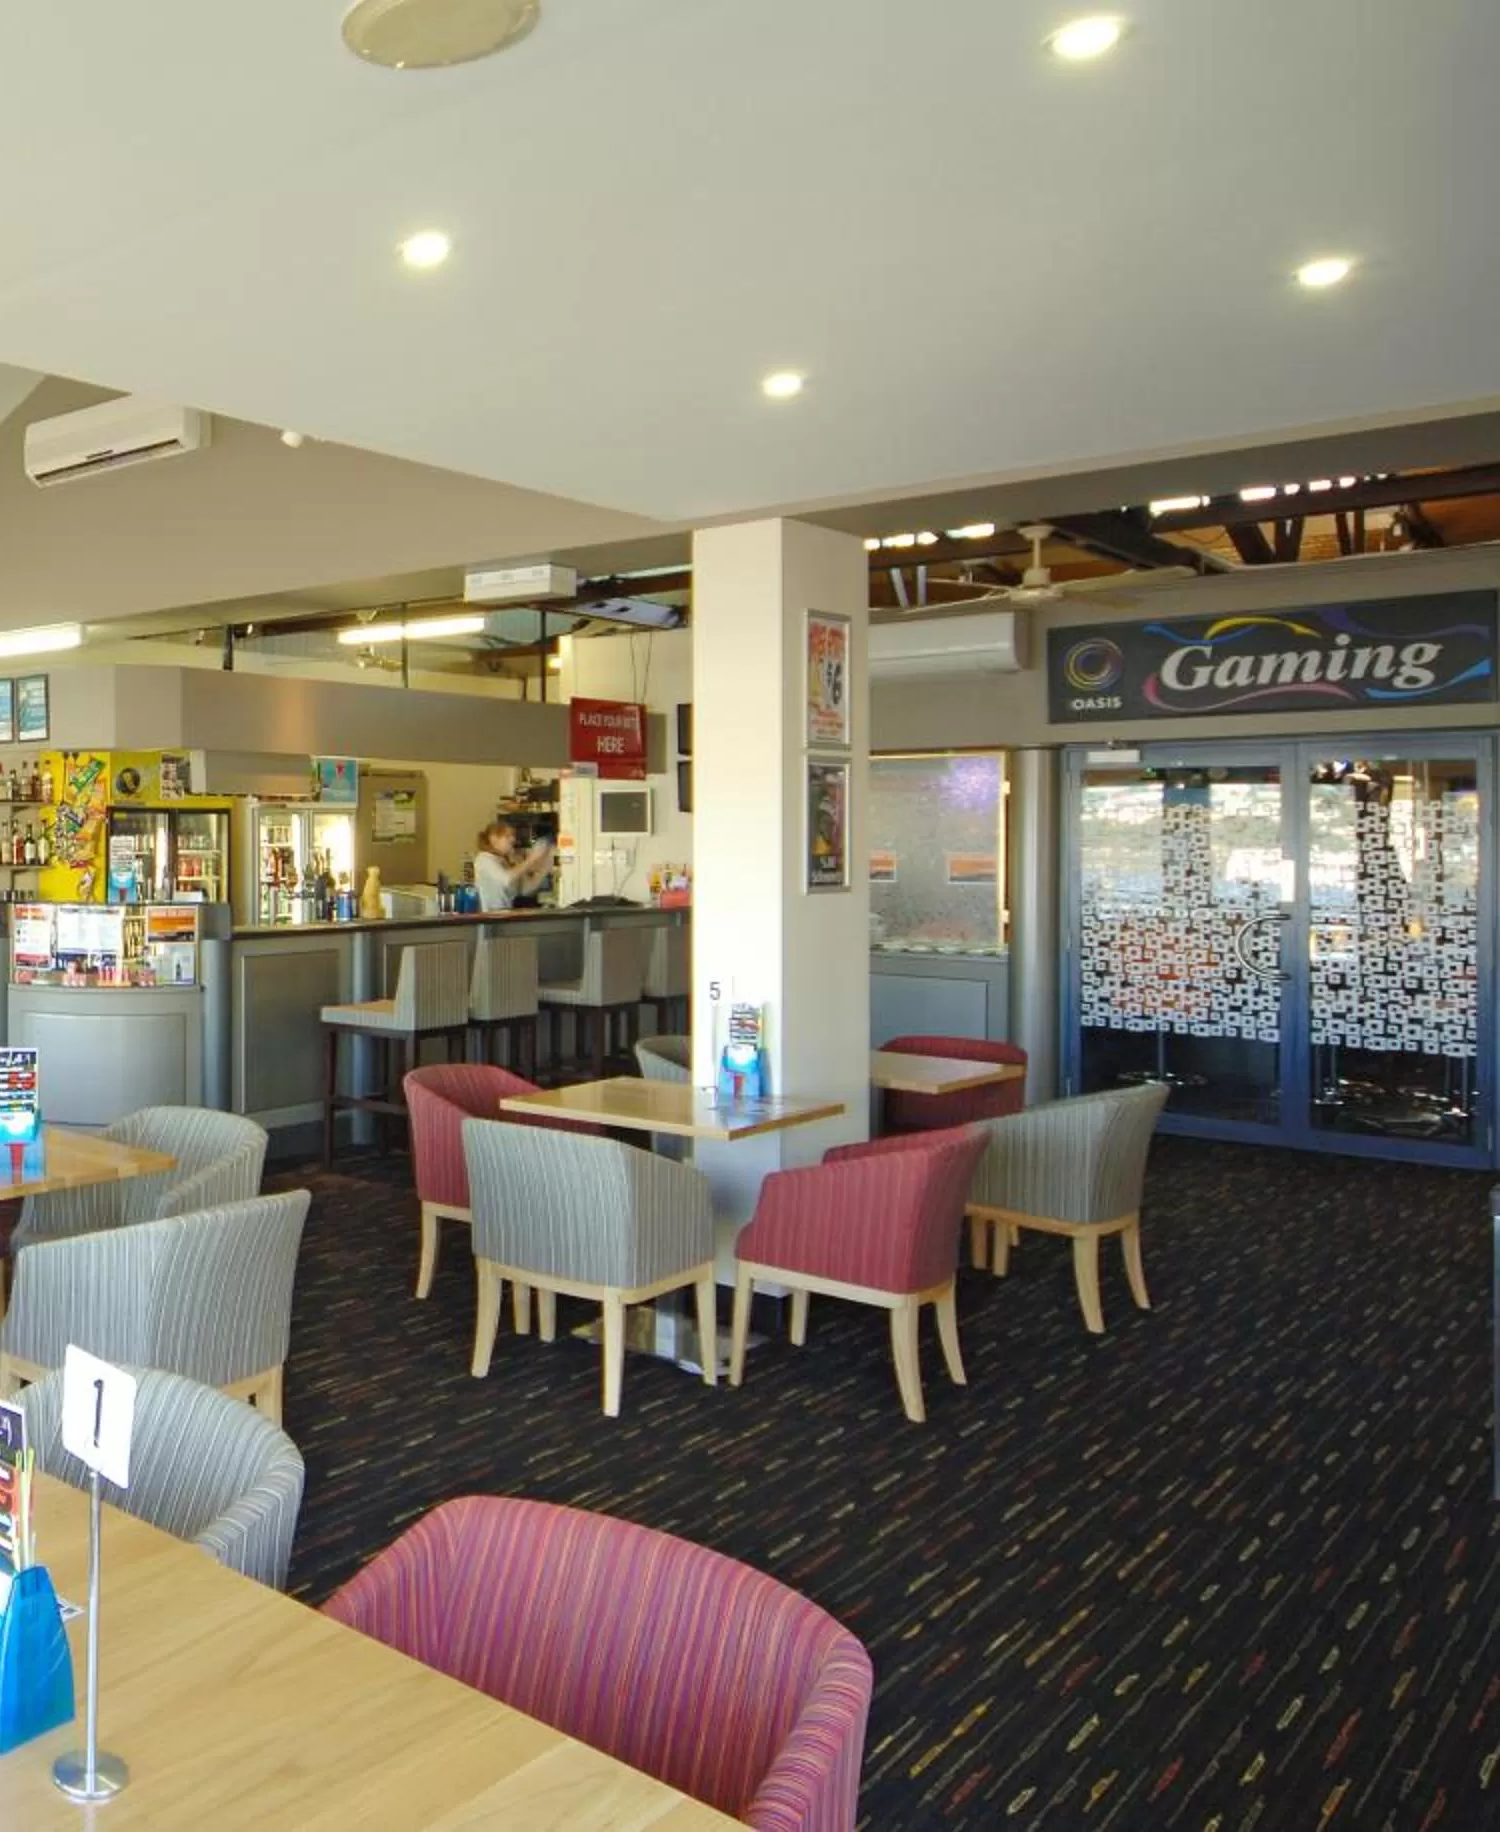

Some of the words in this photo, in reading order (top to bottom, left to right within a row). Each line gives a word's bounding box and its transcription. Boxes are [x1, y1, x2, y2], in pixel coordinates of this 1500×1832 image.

[1160, 633, 1444, 690] Gaming
[1071, 696, 1123, 711] OASIS
[596, 735, 626, 754] HERE
[709, 981, 721, 1001] 5
[93, 1378, 105, 1449] 1
